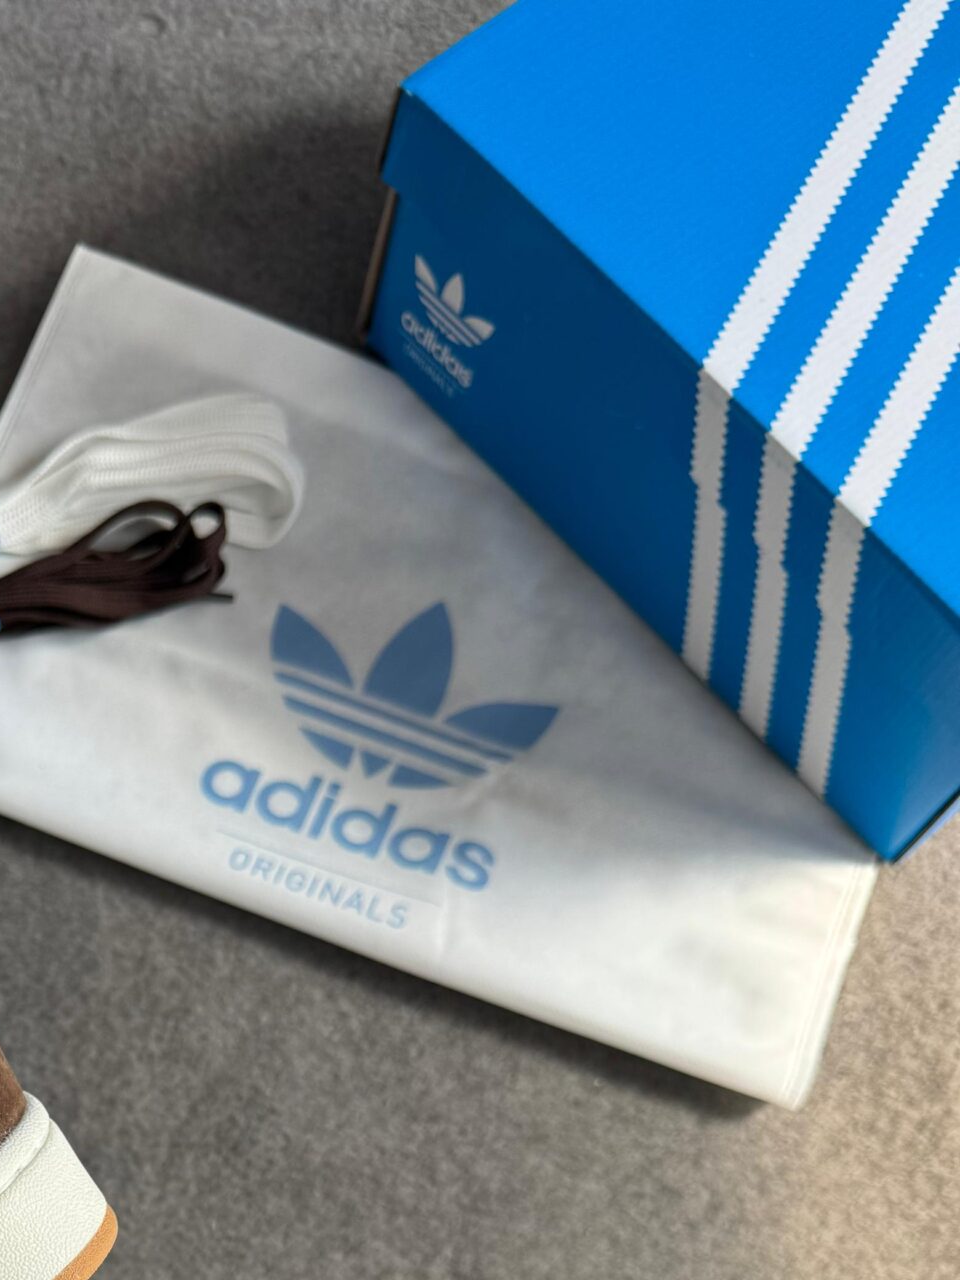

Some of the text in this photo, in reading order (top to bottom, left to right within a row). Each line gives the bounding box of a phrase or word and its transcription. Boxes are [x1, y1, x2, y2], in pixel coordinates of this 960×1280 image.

[401, 312, 473, 388] adidas
[200, 760, 495, 891] adidas
[228, 848, 409, 929] ORIGINALS
